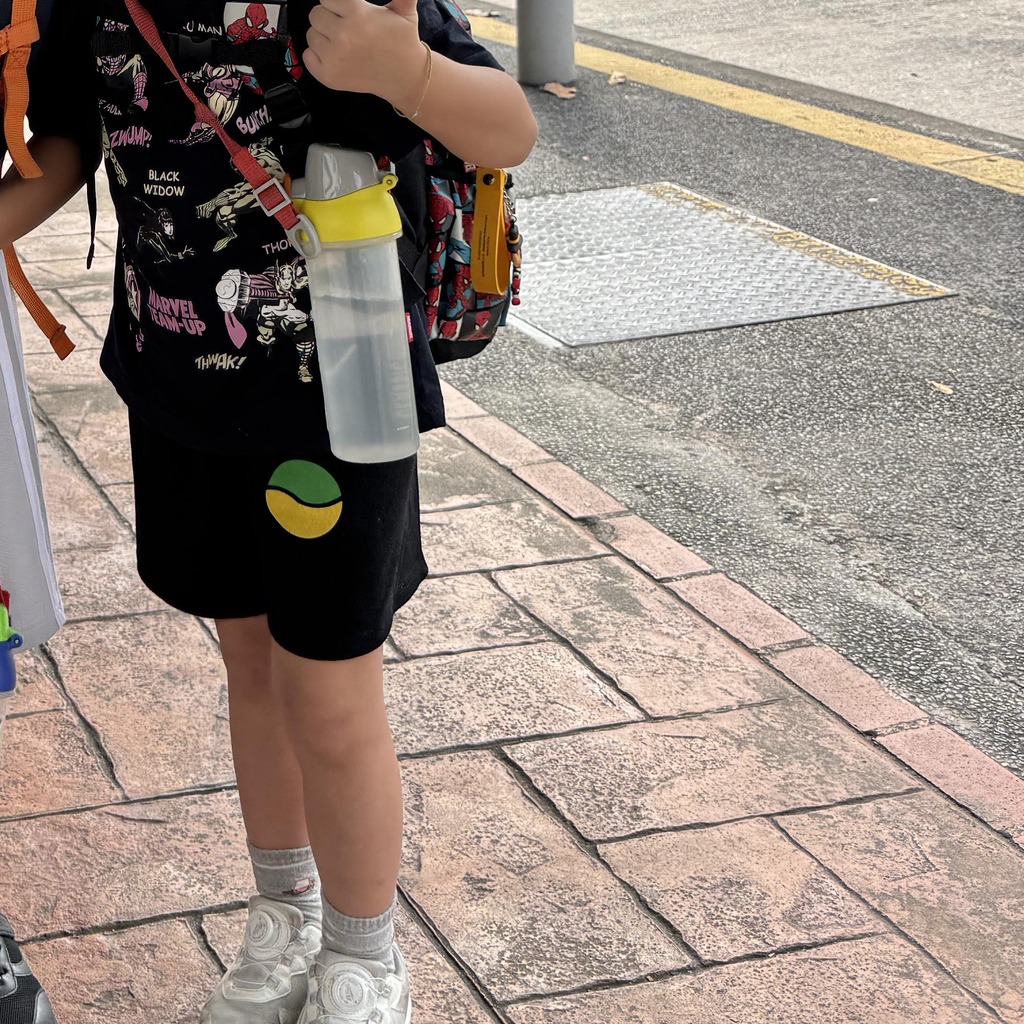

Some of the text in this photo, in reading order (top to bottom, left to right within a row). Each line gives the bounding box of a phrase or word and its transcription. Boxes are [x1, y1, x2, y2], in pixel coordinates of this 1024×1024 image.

[198, 22, 223, 36] MAN
[148, 169, 180, 182] BLACK
[143, 183, 185, 197] WIDOW
[148, 286, 199, 319] MARVEL
[147, 304, 207, 336] TEAM-UP
[195, 353, 247, 370] THWAK!
